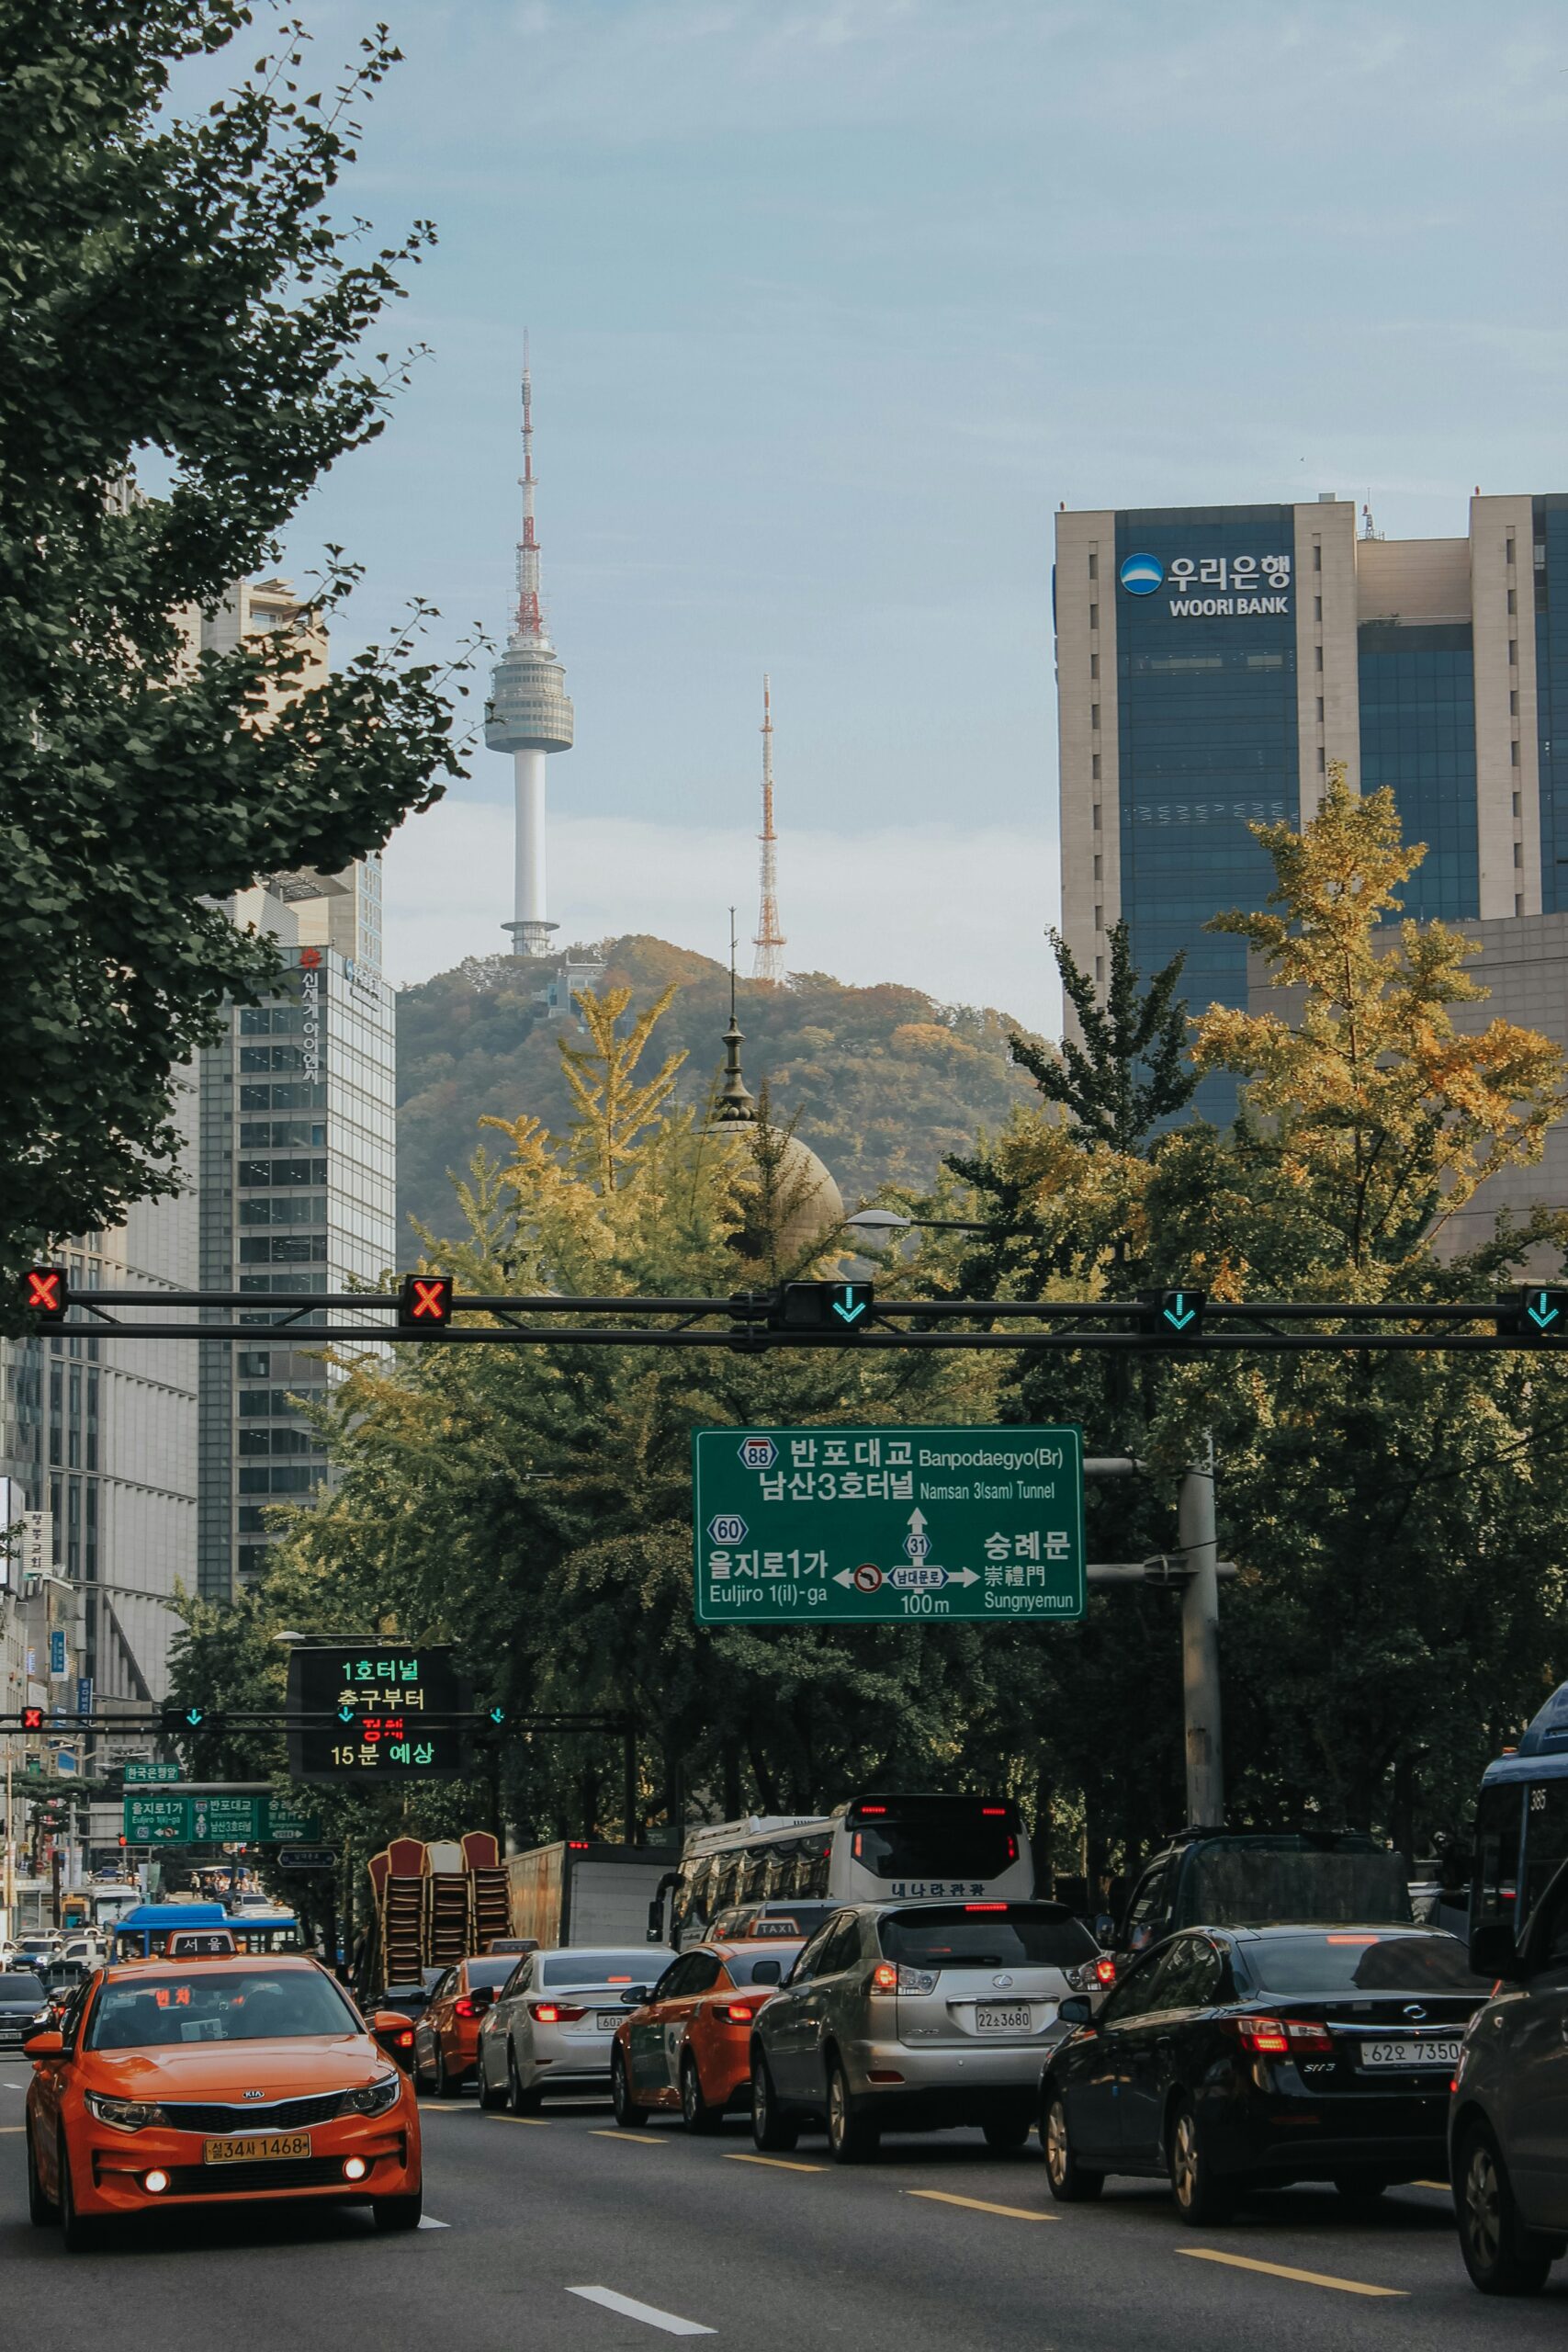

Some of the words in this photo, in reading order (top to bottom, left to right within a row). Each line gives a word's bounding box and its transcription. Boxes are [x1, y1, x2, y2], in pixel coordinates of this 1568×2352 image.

[1168, 555, 1291, 592] 우리은행
[1169, 599, 1233, 616] WOORI
[1237, 597, 1289, 615] BANK
[748, 1447, 769, 1464] 88
[791, 1438, 913, 1468] 반포대교
[919, 1448, 1064, 1470] Banpodaegyo(Br)
[760, 1471, 914, 1500] 남산3호터널
[920, 1482, 970, 1499] Namsan
[974, 1481, 1013, 1499] 3(sam)
[1017, 1480, 1055, 1499] Tunnel
[717, 1521, 739, 1539] 60
[910, 1538, 925, 1554] 31
[984, 1531, 1071, 1560] 숭례문
[708, 1549, 829, 1579] 을지로1가
[897, 1570, 941, 1585] 남대문로
[984, 1566, 1045, 1588] 崇禮門
[710, 1585, 763, 1607] Euljiro
[984, 1591, 1074, 1611] Sungnyemun
[343, 1659, 418, 1681] 1호터널
[389, 1742, 434, 1764] 예상
[129, 1768, 177, 1779] 한국은행앞
[132, 1803, 183, 1815] 을지로1가
[210, 1800, 252, 1811] 반포대교
[210, 1821, 252, 1833] 남산3호터널
[892, 1883, 985, 1896] 내나라관광
[761, 1925, 793, 1934] TAXI
[978, 2013, 1030, 2028] 22소3680
[1371, 2044, 1406, 2062] 62오
[1414, 2042, 1459, 2061] 7350
[245, 2090, 263, 2098] KIA
[261, 2138, 302, 2155] 1468
